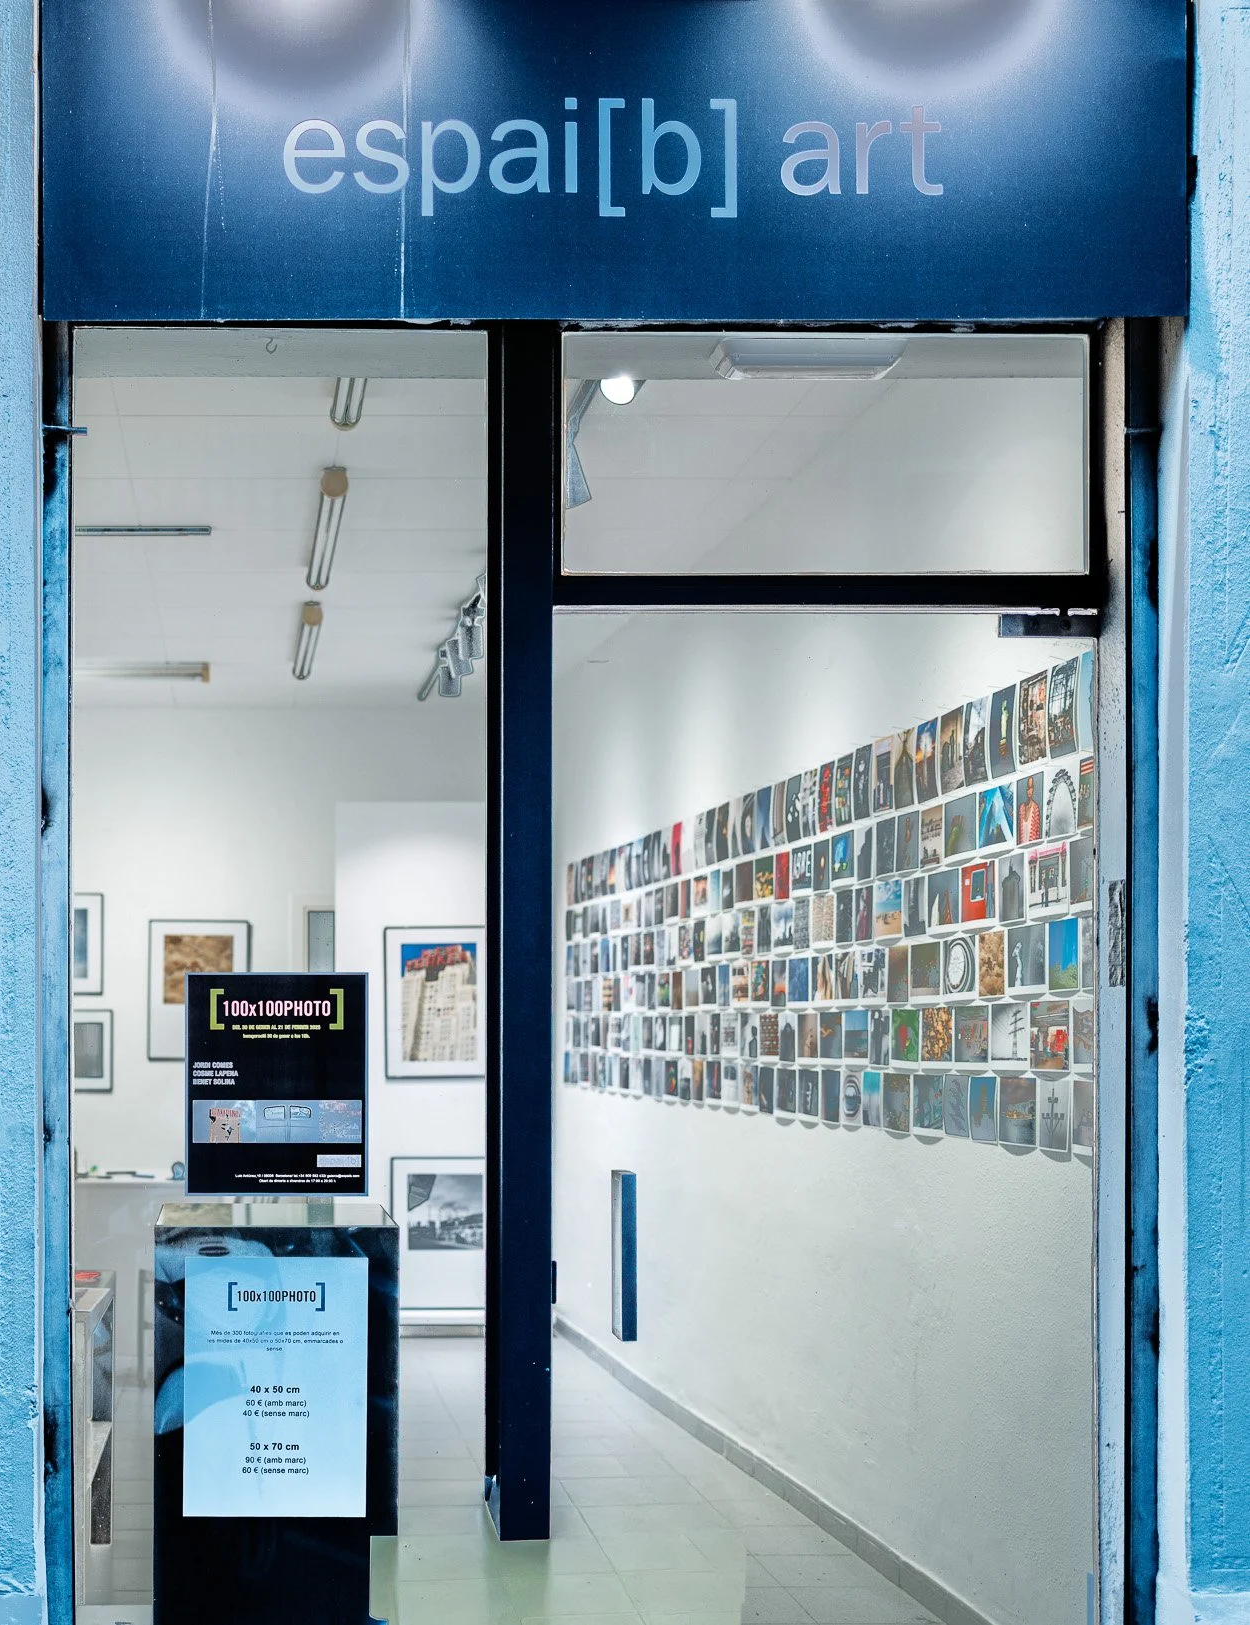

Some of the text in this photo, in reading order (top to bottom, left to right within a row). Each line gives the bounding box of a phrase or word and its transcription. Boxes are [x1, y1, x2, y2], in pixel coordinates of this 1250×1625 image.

[283, 97, 944, 218] espai[b] art
[250, 1386, 261, 1394] 40
[272, 1386, 284, 1394] 50
[264, 1400, 284, 1408] (amb
[285, 1400, 307, 1408] marc)
[261, 1410, 286, 1418] (sense
[288, 1410, 310, 1418] marc)
[250, 1443, 261, 1451] 50
[272, 1443, 283, 1451] 70
[263, 1457, 283, 1465] (amb
[284, 1457, 307, 1465] marc)
[260, 1467, 286, 1475] (sense
[287, 1467, 309, 1475] marc)
